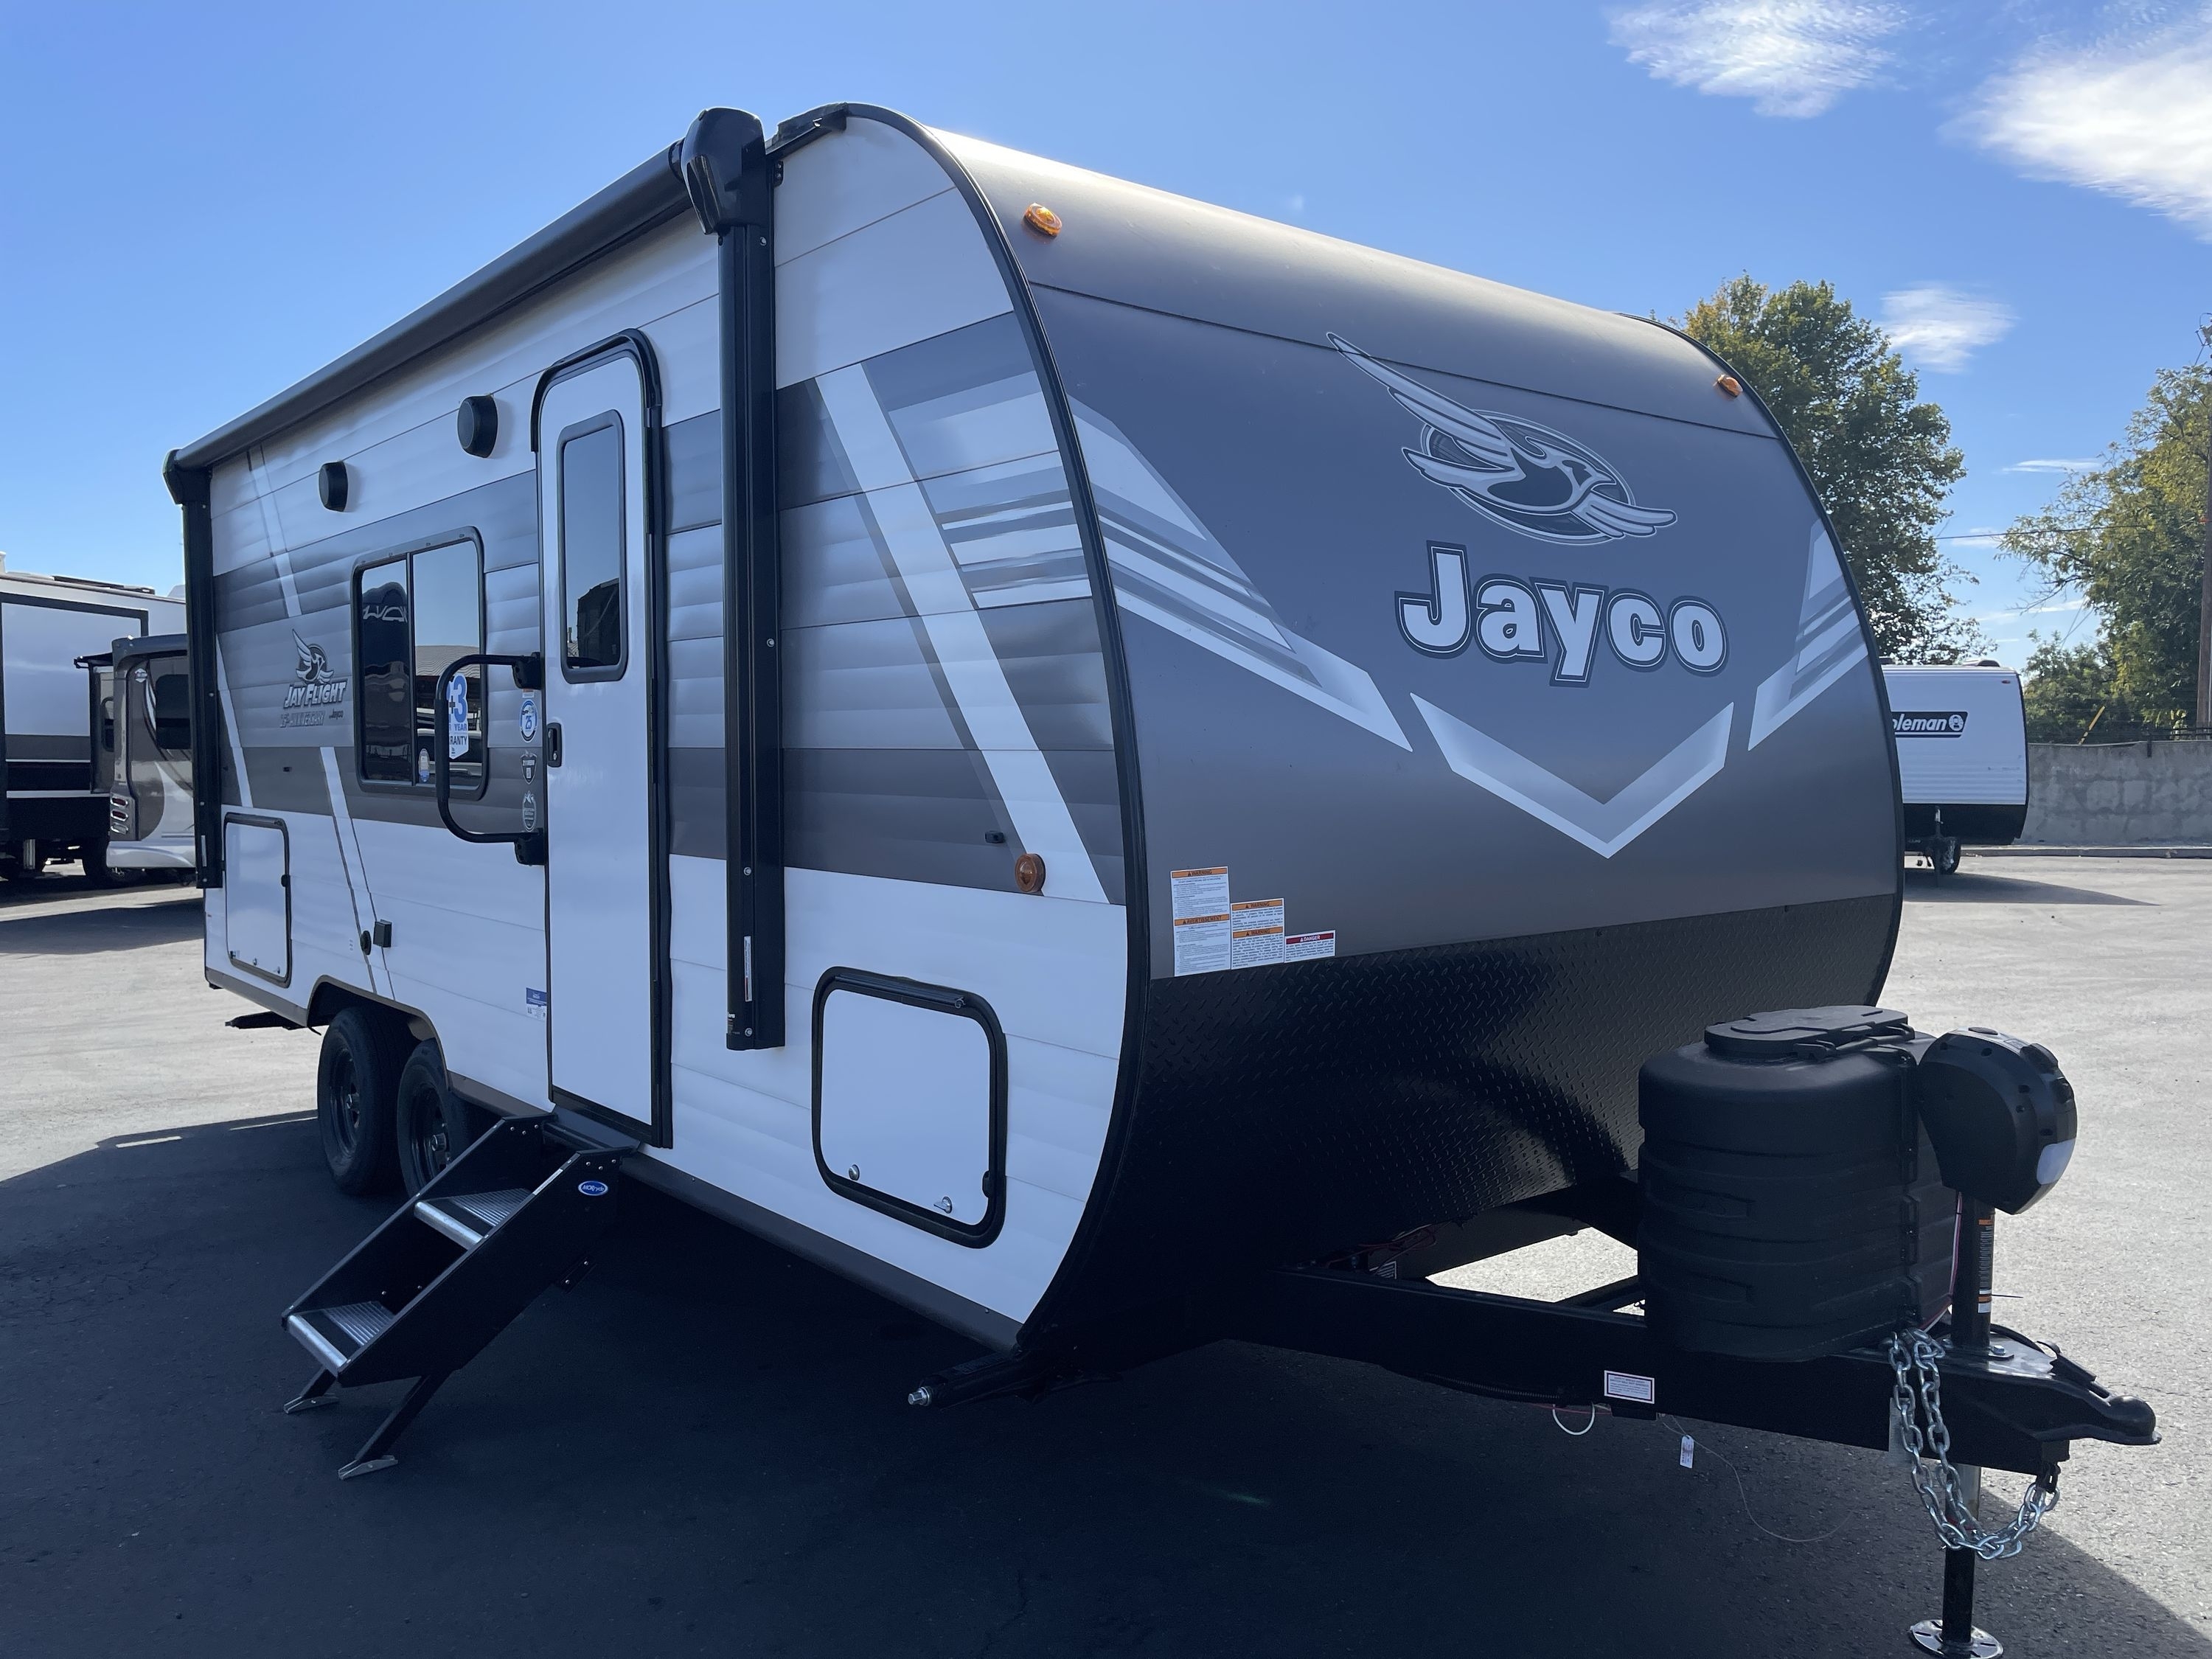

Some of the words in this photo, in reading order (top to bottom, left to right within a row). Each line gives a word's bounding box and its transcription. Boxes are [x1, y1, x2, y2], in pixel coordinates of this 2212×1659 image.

[1396, 542, 1728, 686] Jayco
[284, 685, 306, 709] JAY
[305, 681, 347, 706] FLIGHT
[1892, 713, 1947, 731] leman
[450, 735, 467, 745] RANTY
